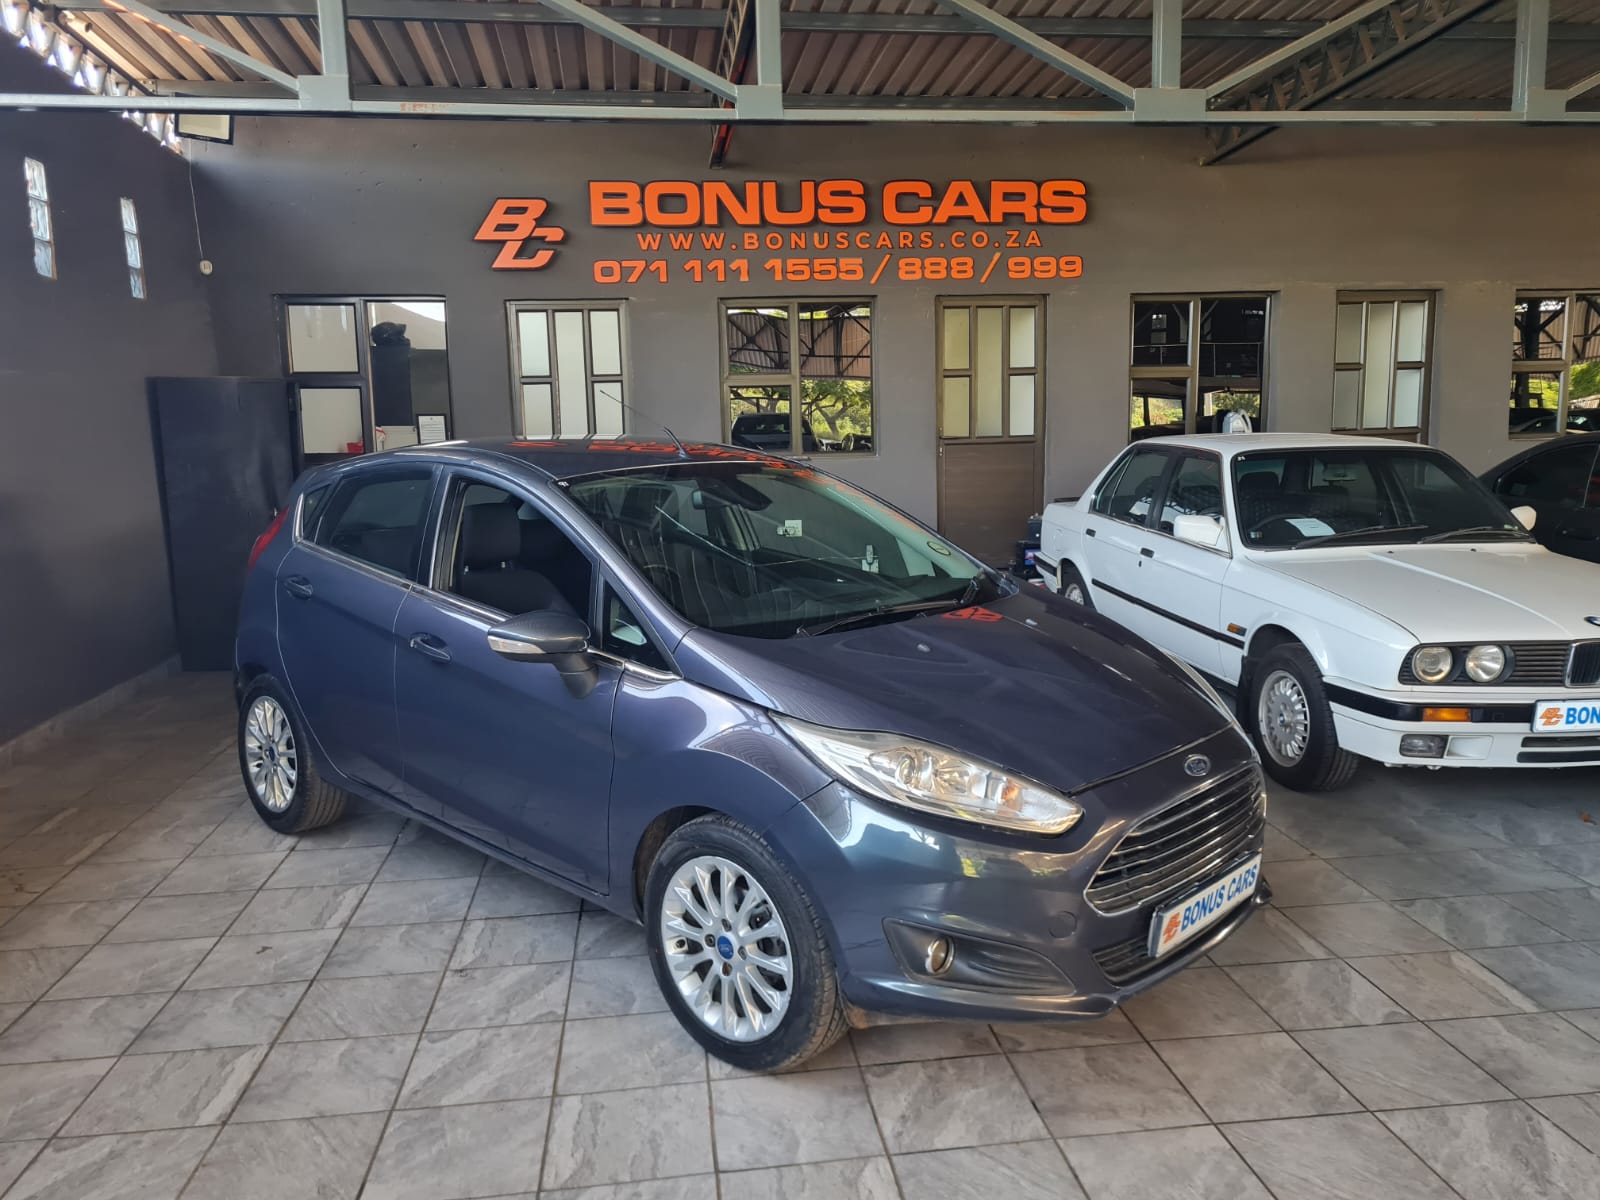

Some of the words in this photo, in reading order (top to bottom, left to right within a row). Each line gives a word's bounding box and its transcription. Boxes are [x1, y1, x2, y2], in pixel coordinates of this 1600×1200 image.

[588, 179, 867, 226] BONUS
[881, 179, 1088, 225] CARS
[636, 230, 1043, 251] WWW.BONUSCARS.CO.ZA
[592, 259, 669, 284] 071
[683, 258, 750, 282] 111
[1181, 884, 1226, 932] BONUS
[1227, 863, 1258, 901] CARS
